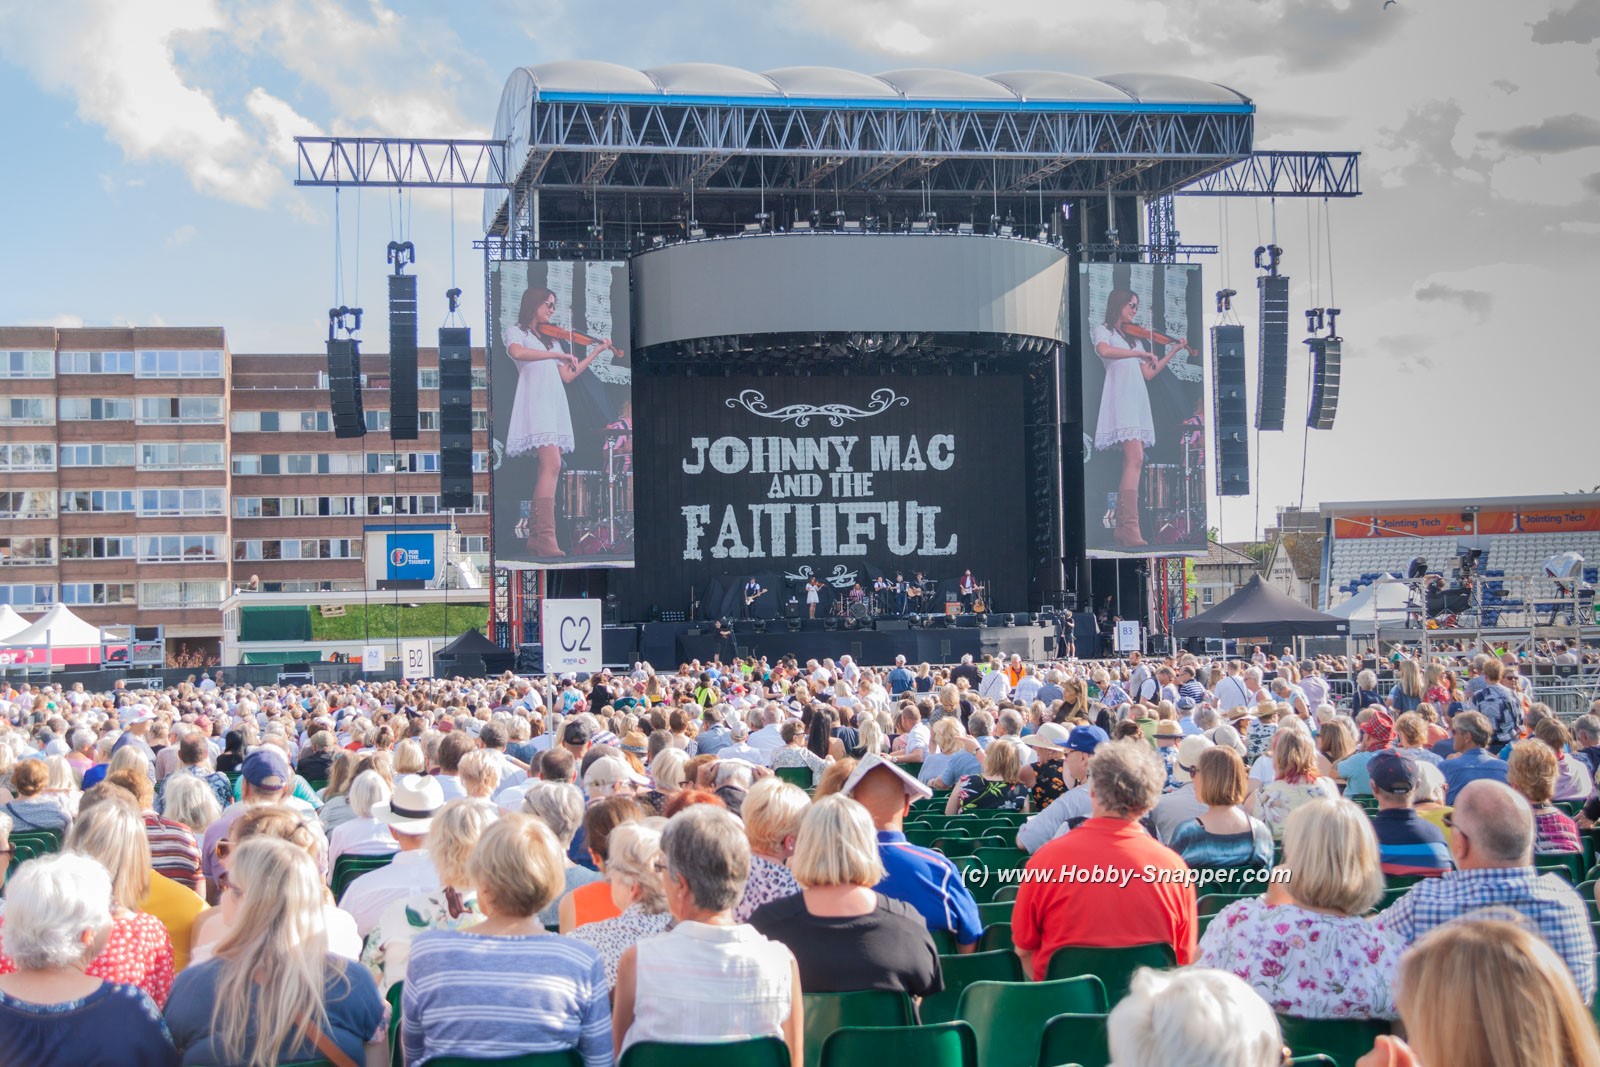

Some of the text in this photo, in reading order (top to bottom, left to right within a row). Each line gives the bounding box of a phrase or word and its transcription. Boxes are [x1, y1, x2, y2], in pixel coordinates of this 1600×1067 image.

[682, 434, 955, 474] JOHNNY MAC
[767, 472, 874, 498] AND THE
[1382, 518, 1418, 529] Jointing
[1421, 517, 1441, 526] Tech
[1525, 515, 1562, 524] Jointing
[1564, 513, 1585, 522] Tech
[681, 500, 958, 561] FAITHFUL
[560, 616, 591, 652] C2
[1123, 626, 1133, 635] B3
[368, 650, 379, 659] A2
[409, 649, 423, 668] B2
